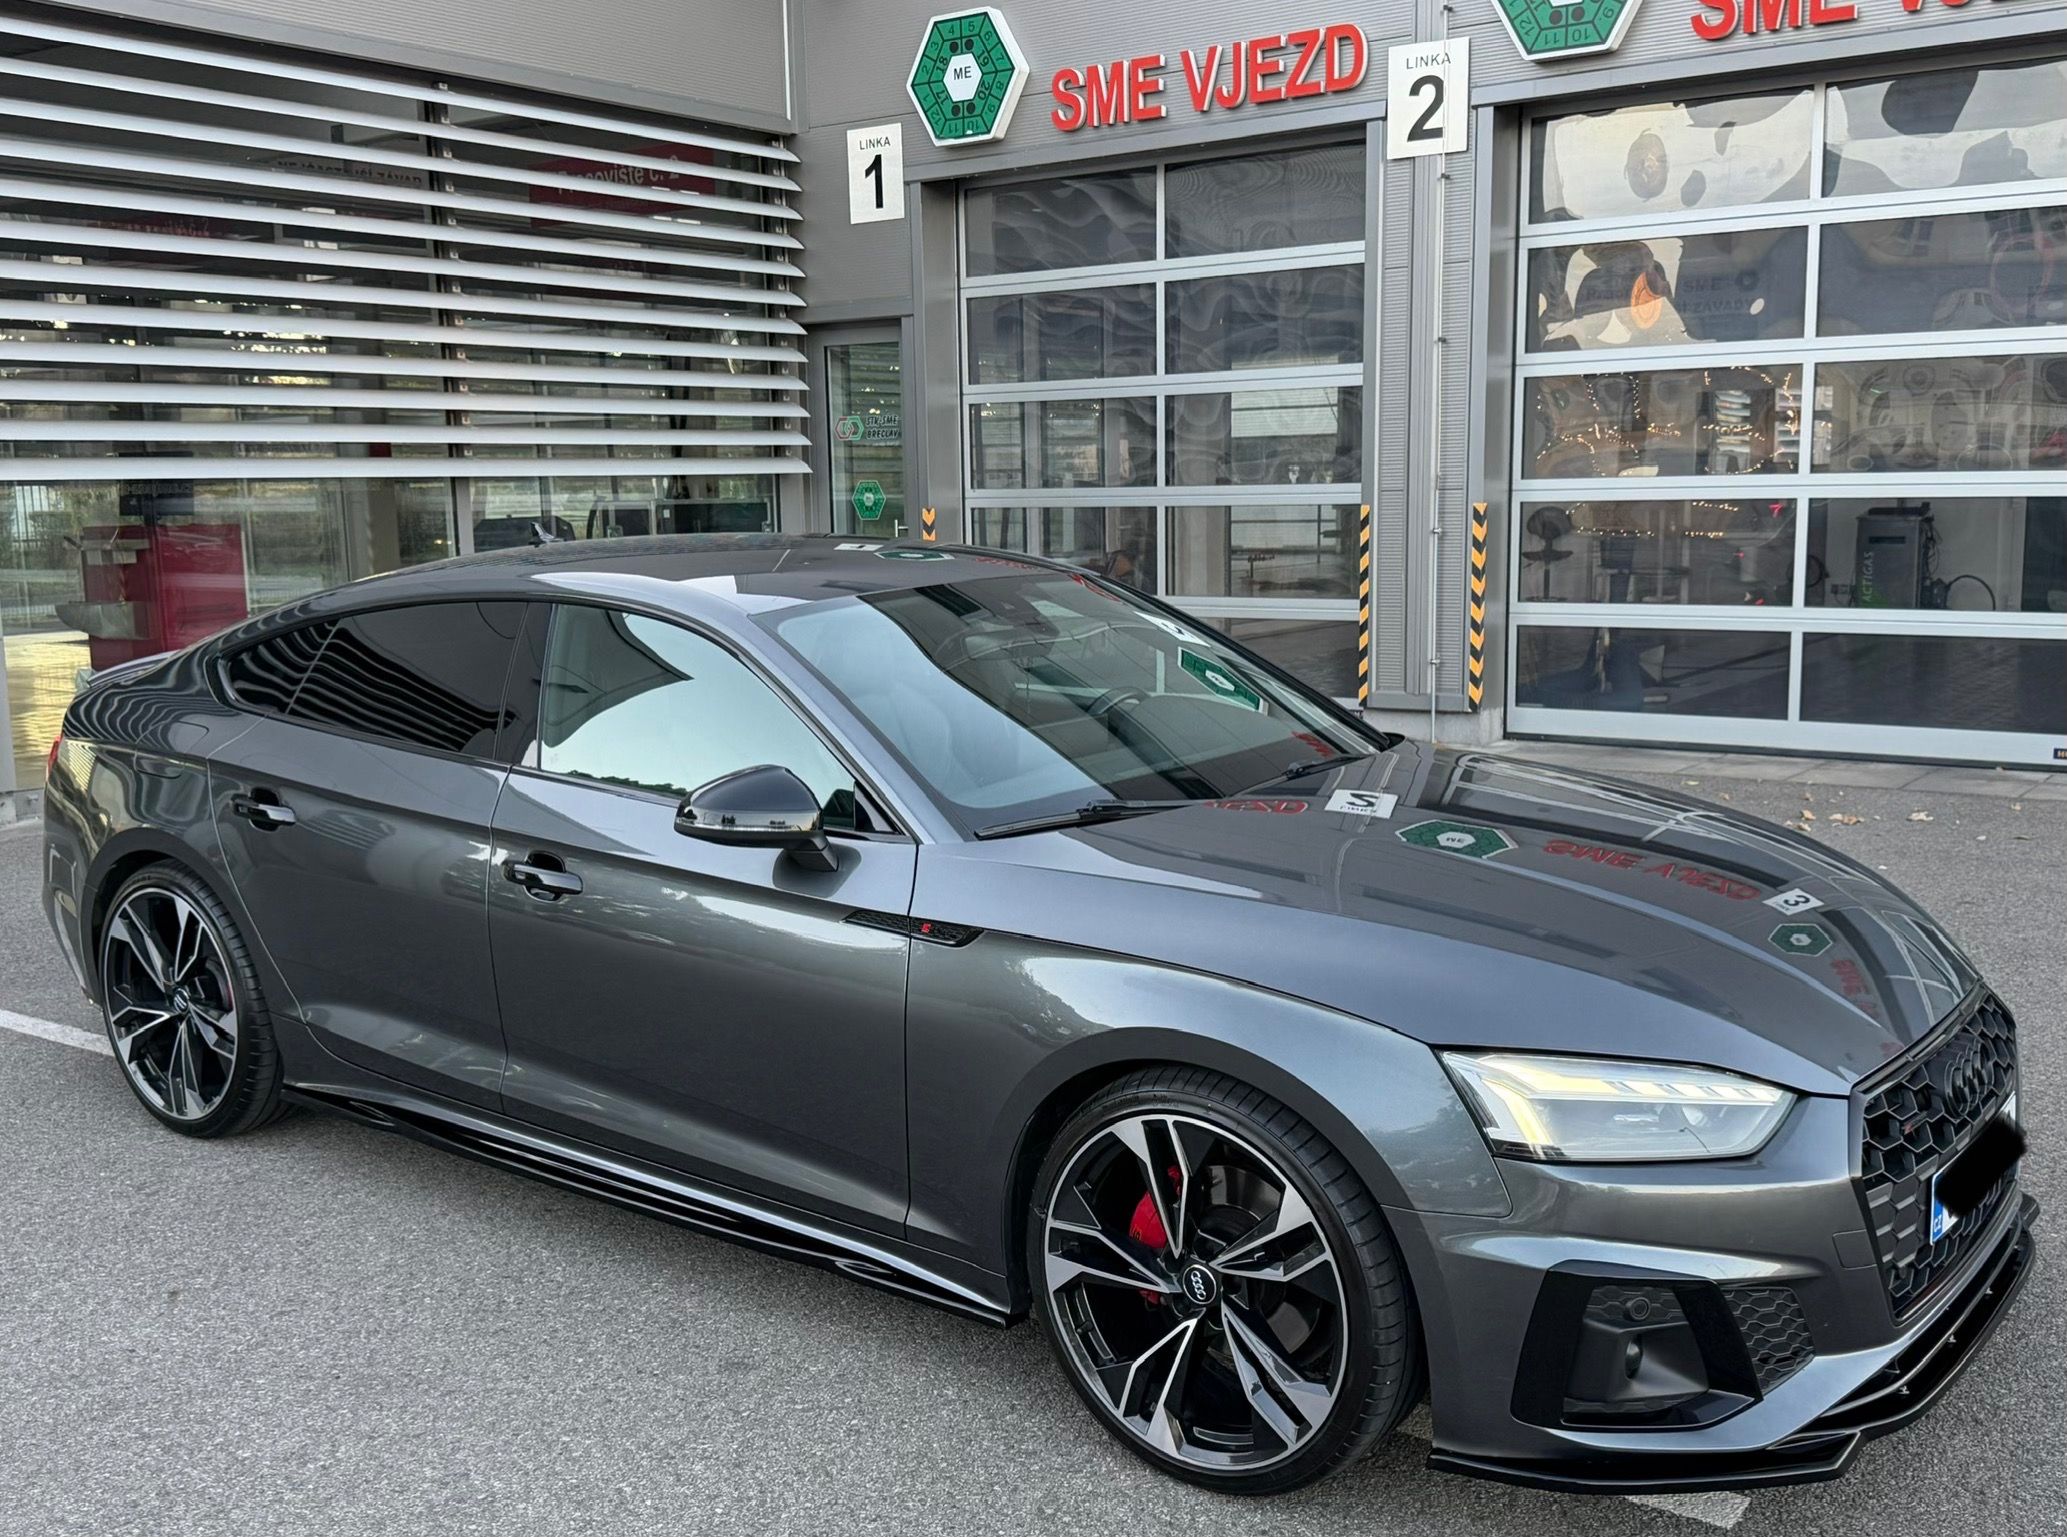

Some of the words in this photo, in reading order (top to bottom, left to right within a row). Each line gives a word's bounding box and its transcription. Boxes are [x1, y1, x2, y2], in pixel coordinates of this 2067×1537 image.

[948, 24, 955, 36] 4
[967, 20, 976, 32] 5
[1543, 33, 1560, 46] 11
[1572, 28, 1591, 42] 10
[930, 41, 940, 51] 3
[935, 55, 948, 74] 18
[977, 49, 989, 67] 19
[1406, 52, 1451, 70] LINKA
[921, 65, 930, 75] 2
[953, 66, 972, 80] ME
[1051, 53, 1167, 132] SME
[1180, 22, 1368, 112] VJEZD
[977, 80, 991, 101] 20
[995, 80, 1005, 90] 8
[1406, 74, 1444, 143] 2
[948, 122, 959, 134] 11
[967, 120, 980, 131] 10
[859, 136, 891, 150] LINKA
[864, 153, 884, 209] 1
[1862, 551, 1874, 602] ACTIGAS
